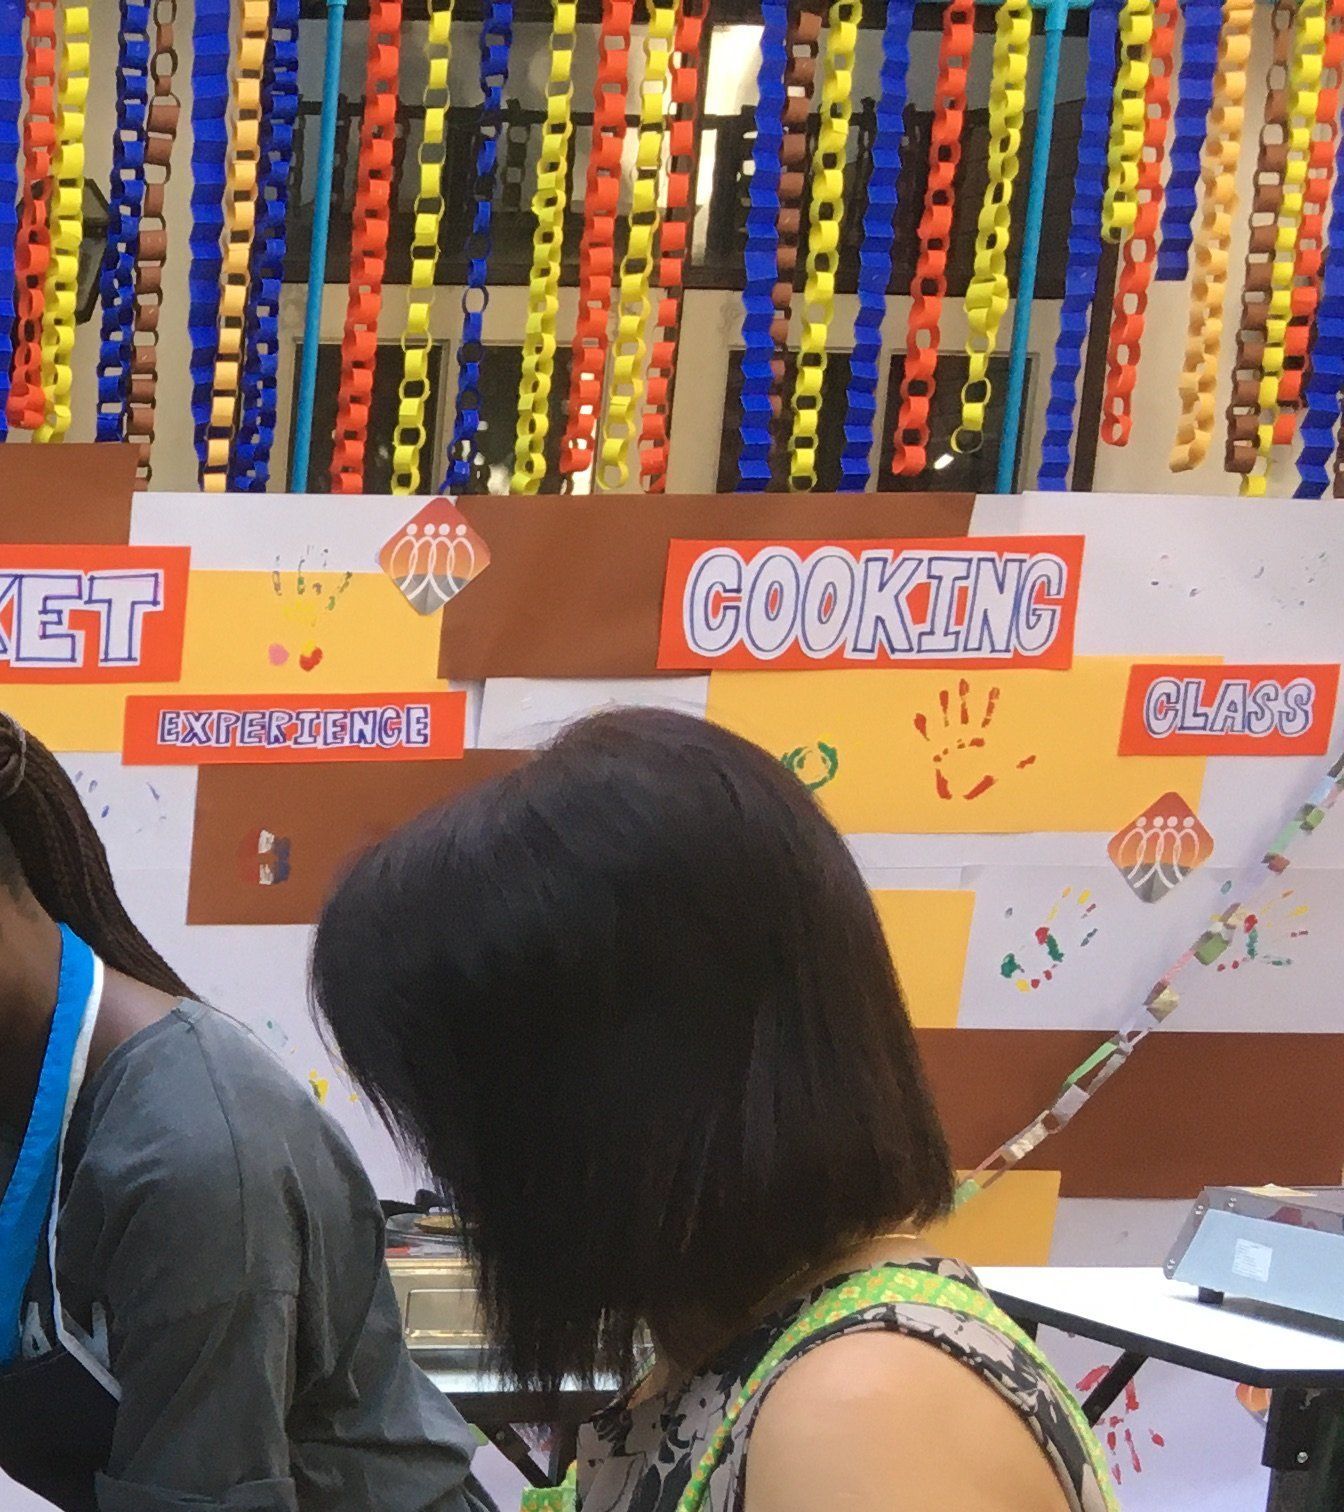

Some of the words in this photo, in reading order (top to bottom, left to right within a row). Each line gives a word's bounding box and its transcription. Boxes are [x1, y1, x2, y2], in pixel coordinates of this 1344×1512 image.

[683, 547, 1069, 660] COOKING
[156, 705, 431, 749] EXPERIENCE
[1143, 676, 1317, 739] CLASS
